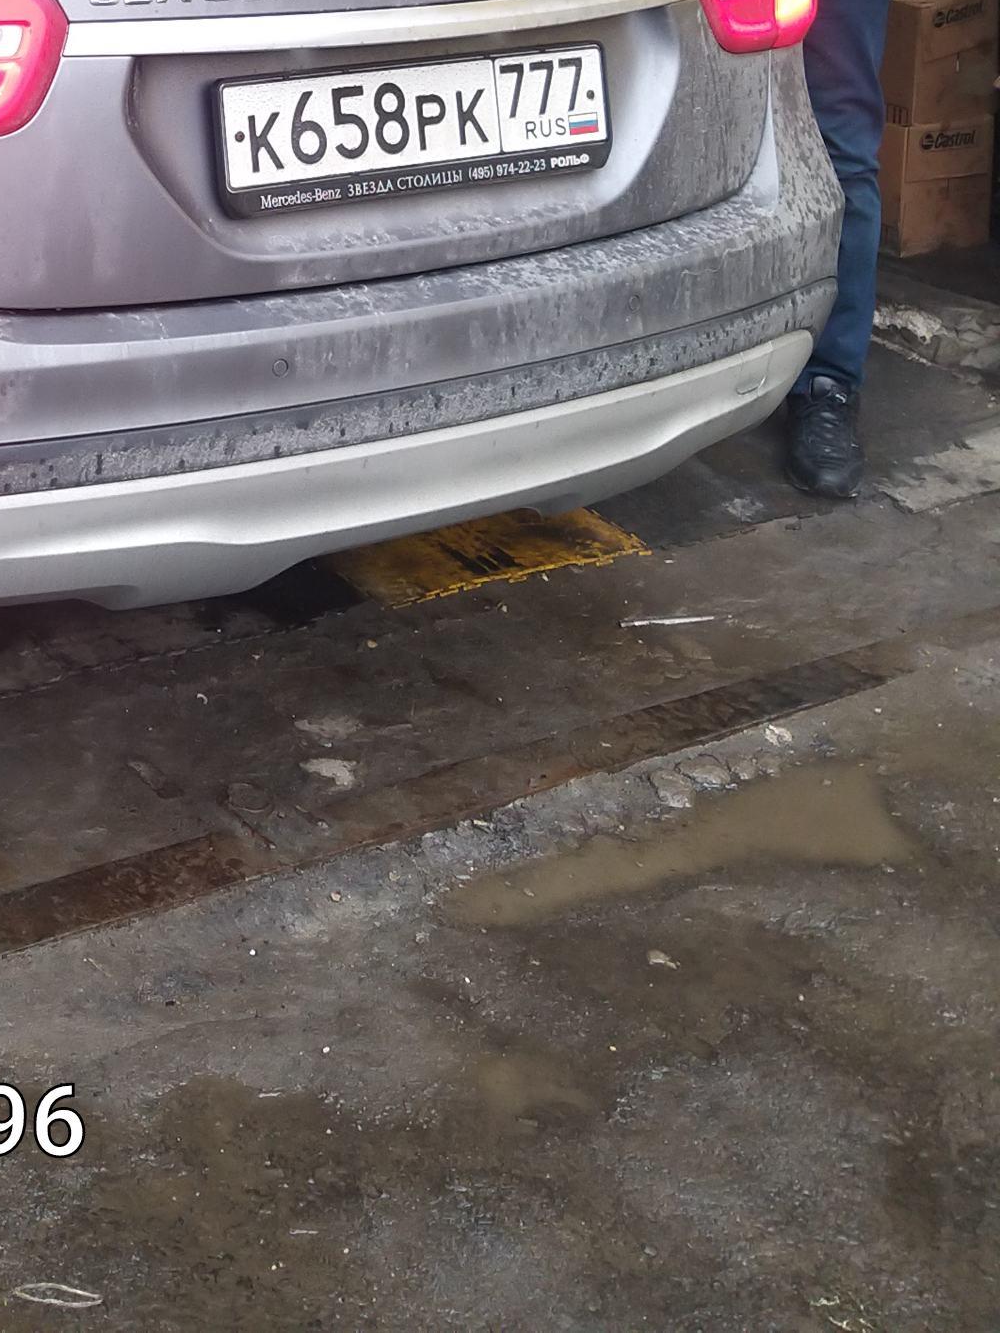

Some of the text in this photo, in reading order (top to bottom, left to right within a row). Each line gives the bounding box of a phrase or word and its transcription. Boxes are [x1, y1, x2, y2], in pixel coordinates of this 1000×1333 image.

[499, 57, 583, 119] 777
[525, 118, 567, 140] RUS
[935, 130, 976, 149] Castrol
[260, 153, 591, 209] Mercedes-Benz ЗВЕЗДА СТОЛИЦЫ (495) 974-22-23 РОЛЬФ
